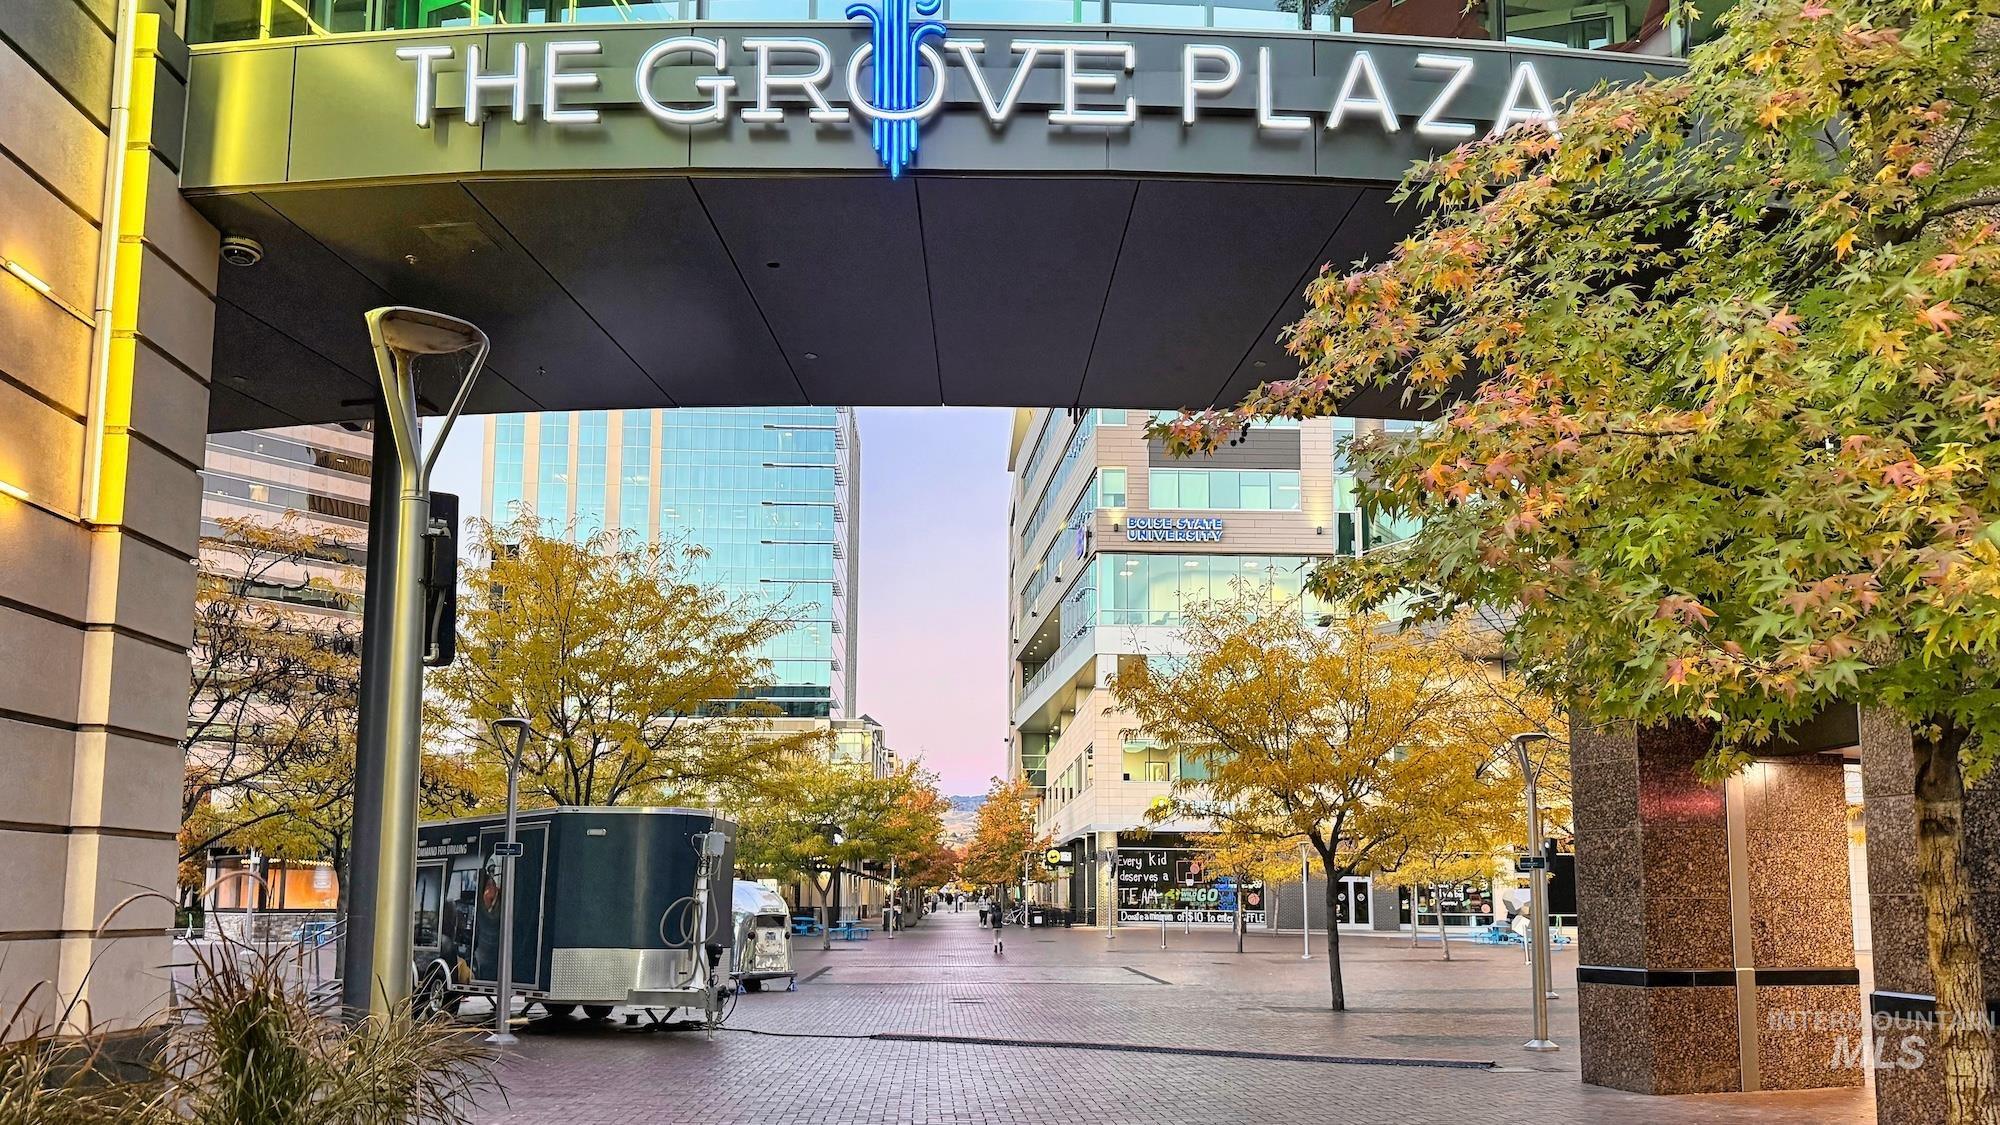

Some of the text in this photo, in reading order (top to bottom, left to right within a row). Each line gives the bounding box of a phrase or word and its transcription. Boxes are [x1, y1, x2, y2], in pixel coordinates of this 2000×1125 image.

[396, 36, 1562, 140] THE GROVE PLAZA
[1126, 517, 1224, 530] BOISE STATE
[1126, 530, 1224, 542] UNIVERSITY
[1117, 854, 1142, 869] Every
[1119, 869, 1169, 882] deserves a
[1207, 911, 1216, 922] to
